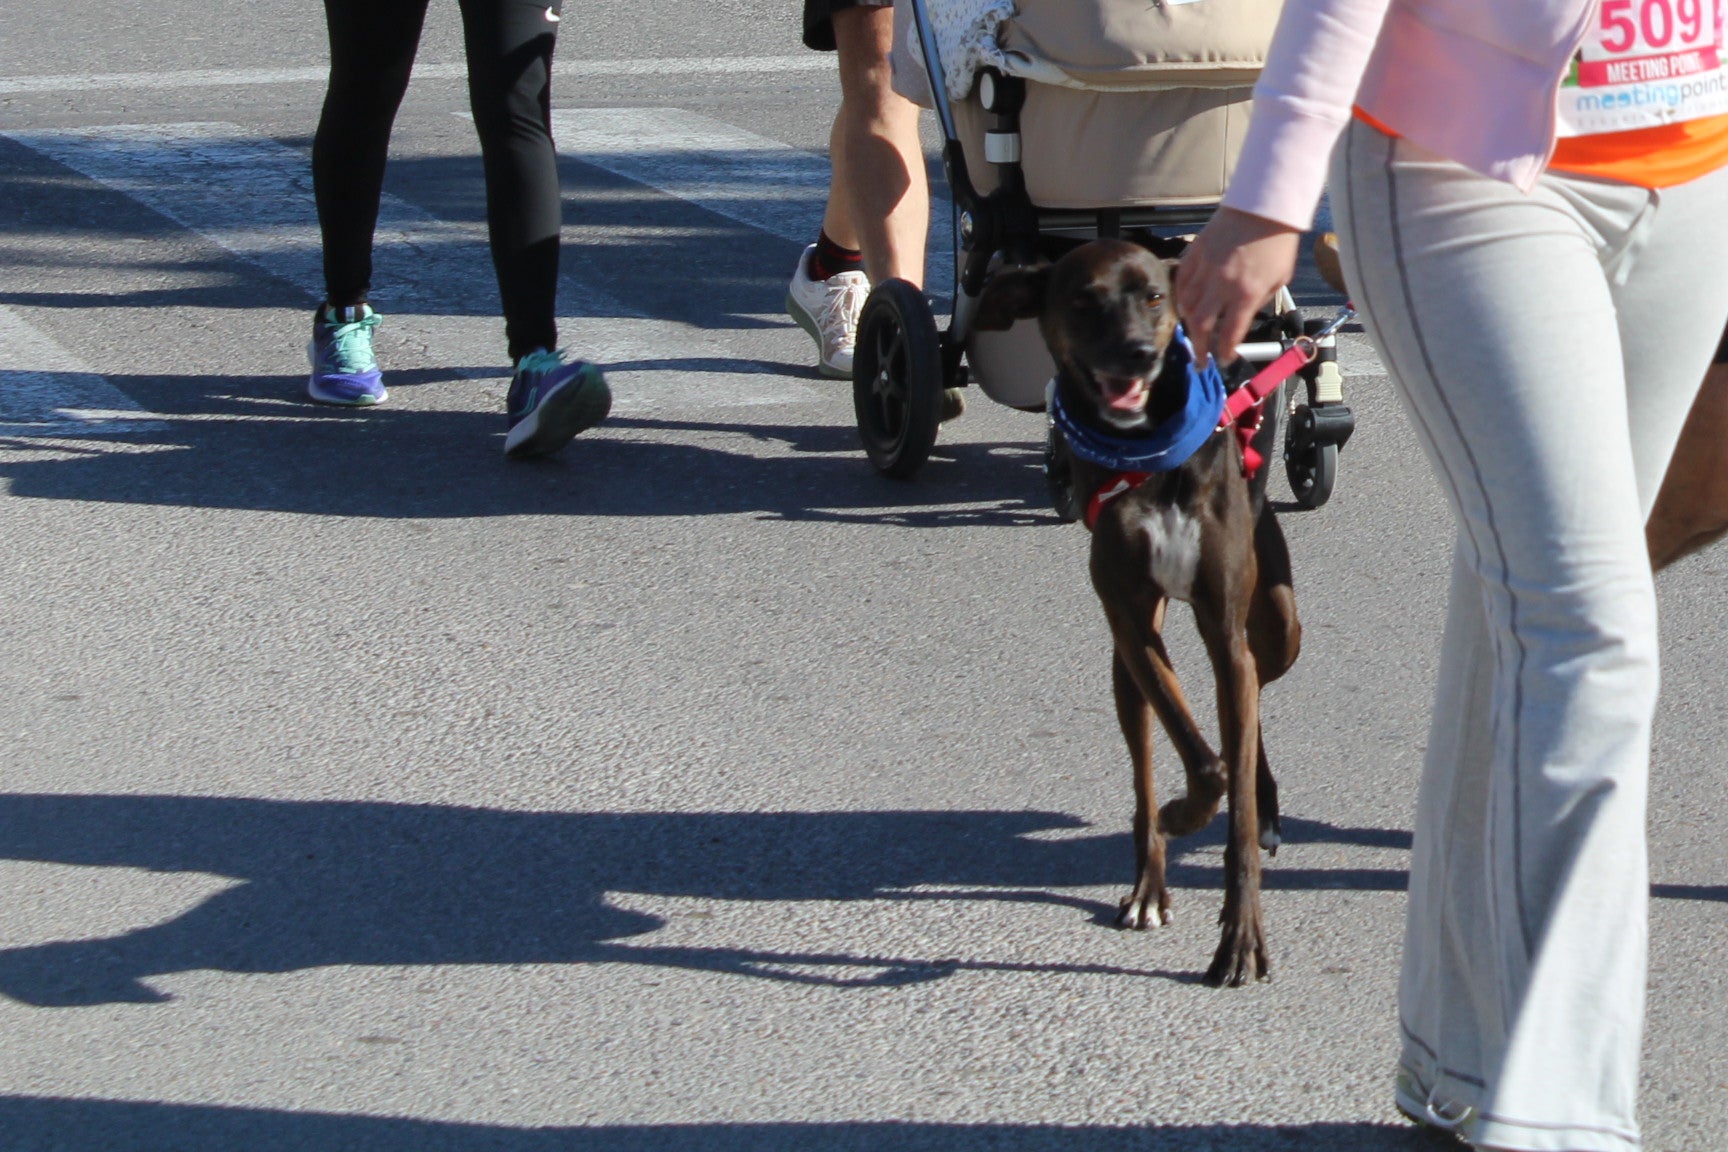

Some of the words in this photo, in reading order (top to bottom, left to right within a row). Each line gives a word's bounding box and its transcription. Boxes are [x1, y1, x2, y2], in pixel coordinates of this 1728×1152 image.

[1606, 56, 1669, 83] MEETING
[1670, 50, 1702, 76] POINT
[1576, 73, 1728, 111] meetingpoint
